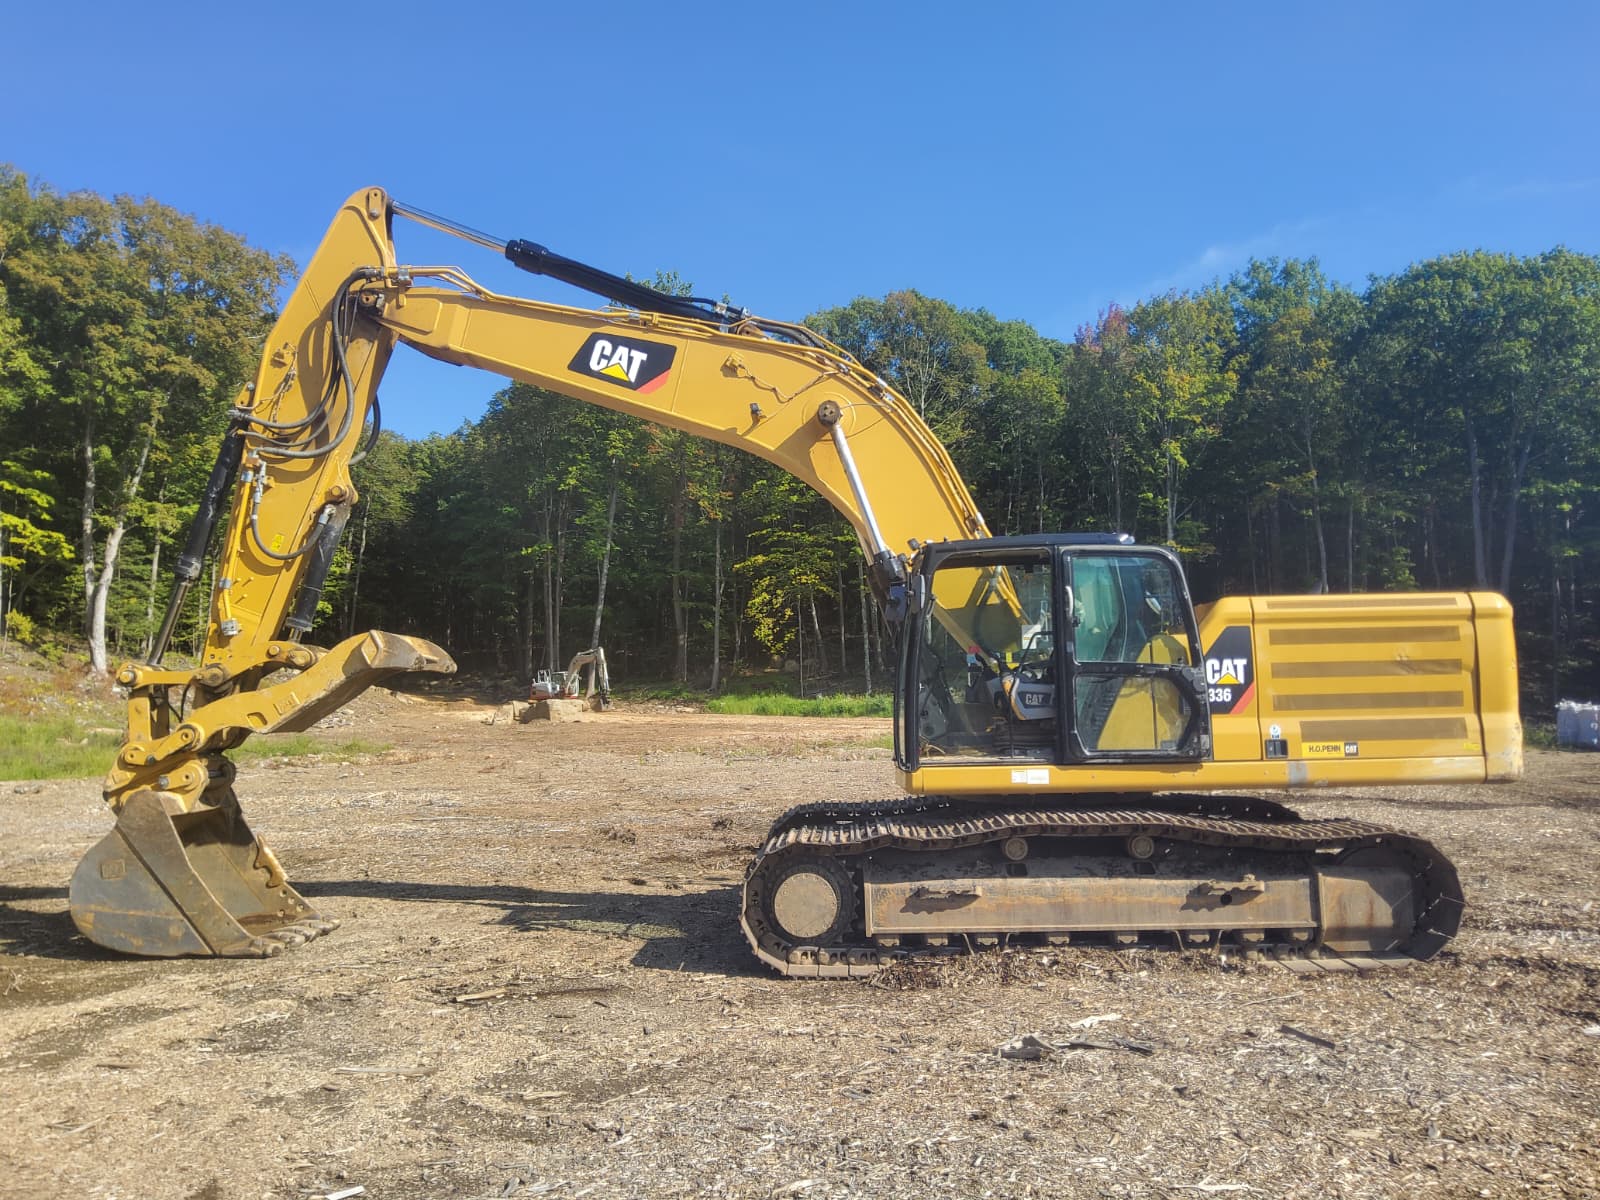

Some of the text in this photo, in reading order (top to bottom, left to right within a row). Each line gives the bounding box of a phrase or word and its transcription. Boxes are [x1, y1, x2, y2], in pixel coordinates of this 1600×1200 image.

[589, 339, 648, 383] CAT
[1205, 658, 1248, 685] CAT
[1025, 693, 1044, 705] CAT
[1208, 688, 1232, 702] 336
